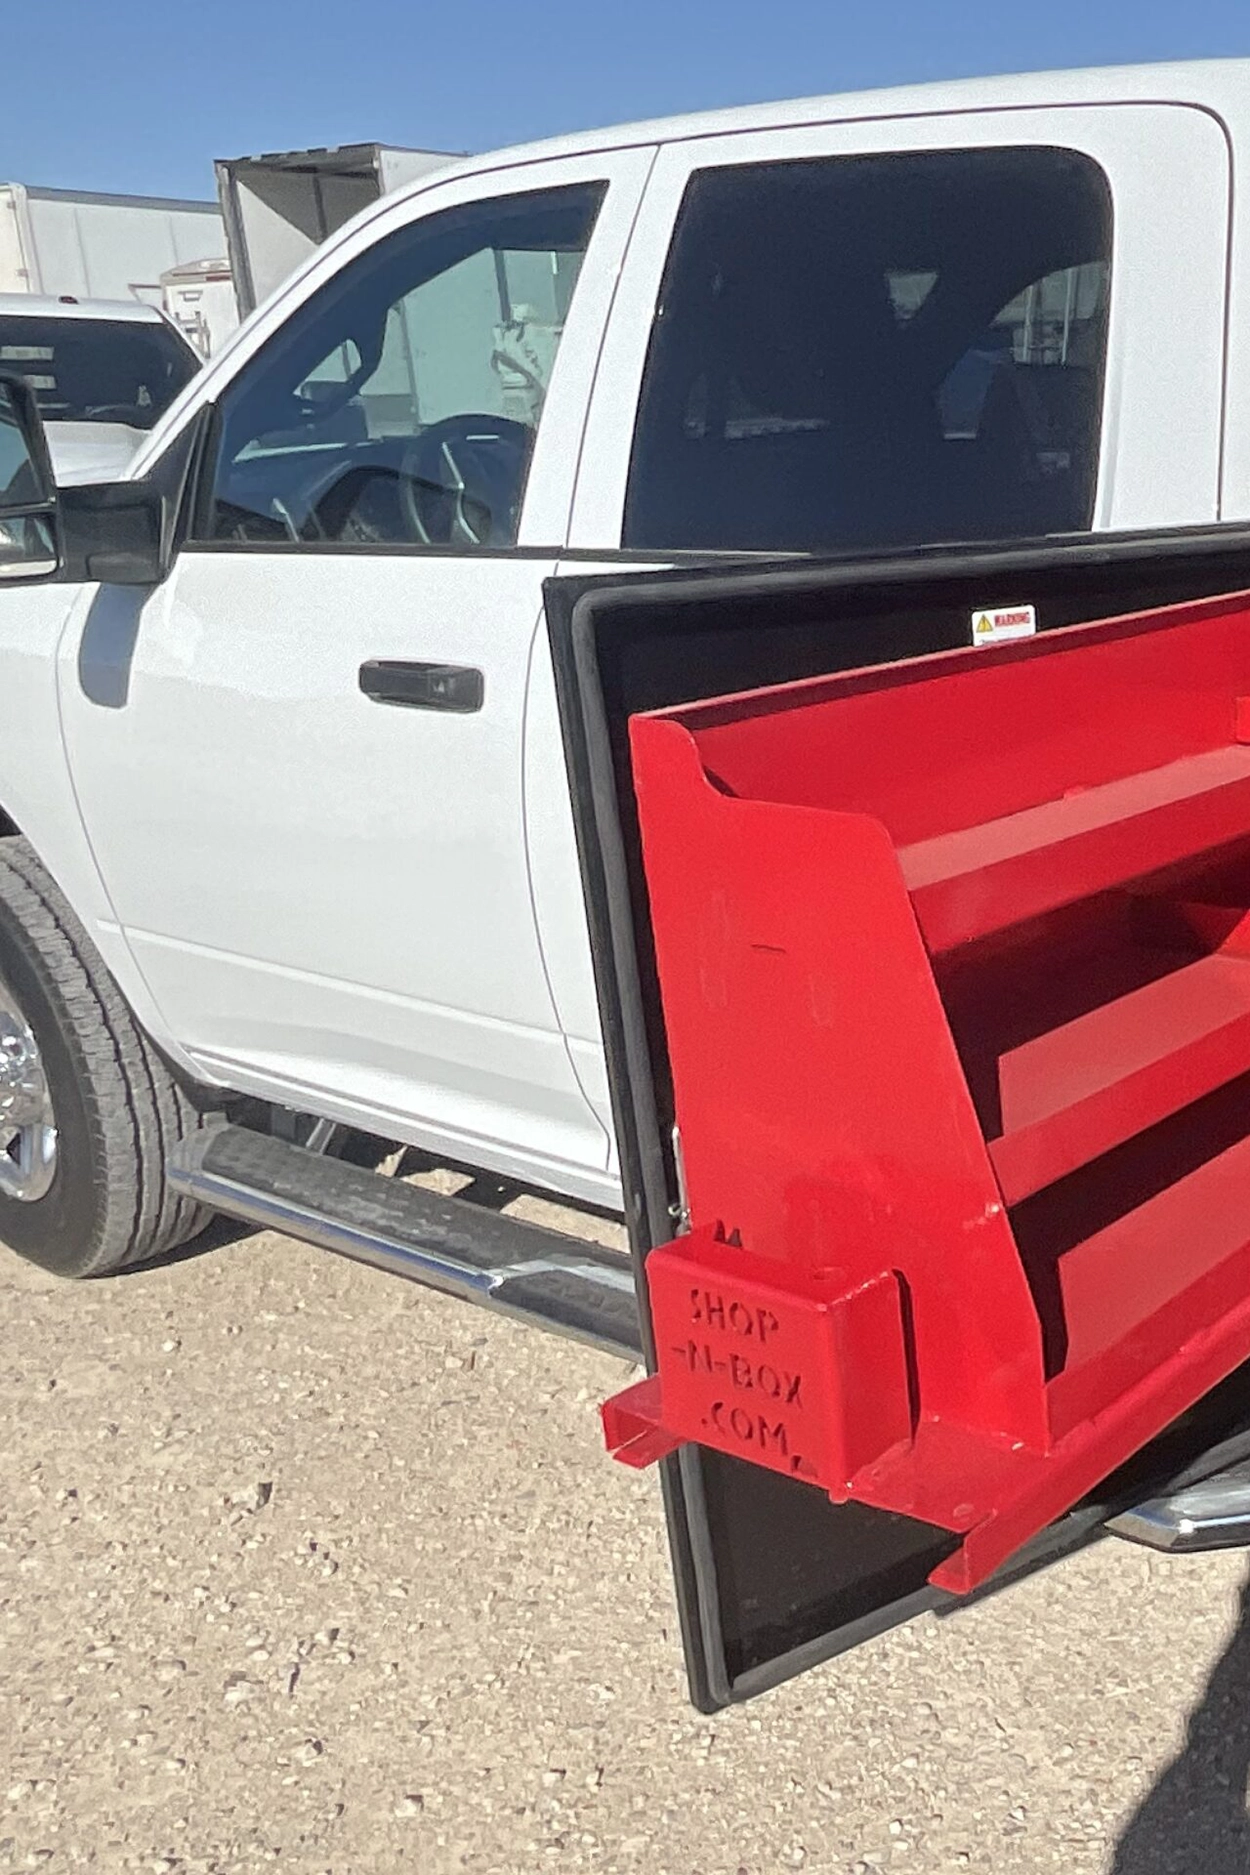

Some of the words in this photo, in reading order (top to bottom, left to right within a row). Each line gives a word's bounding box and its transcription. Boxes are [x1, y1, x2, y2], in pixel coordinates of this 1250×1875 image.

[689, 1288, 780, 1342] SHOP
[670, 1338, 802, 1408] -N-BOX
[701, 1401, 788, 1456] .COM
